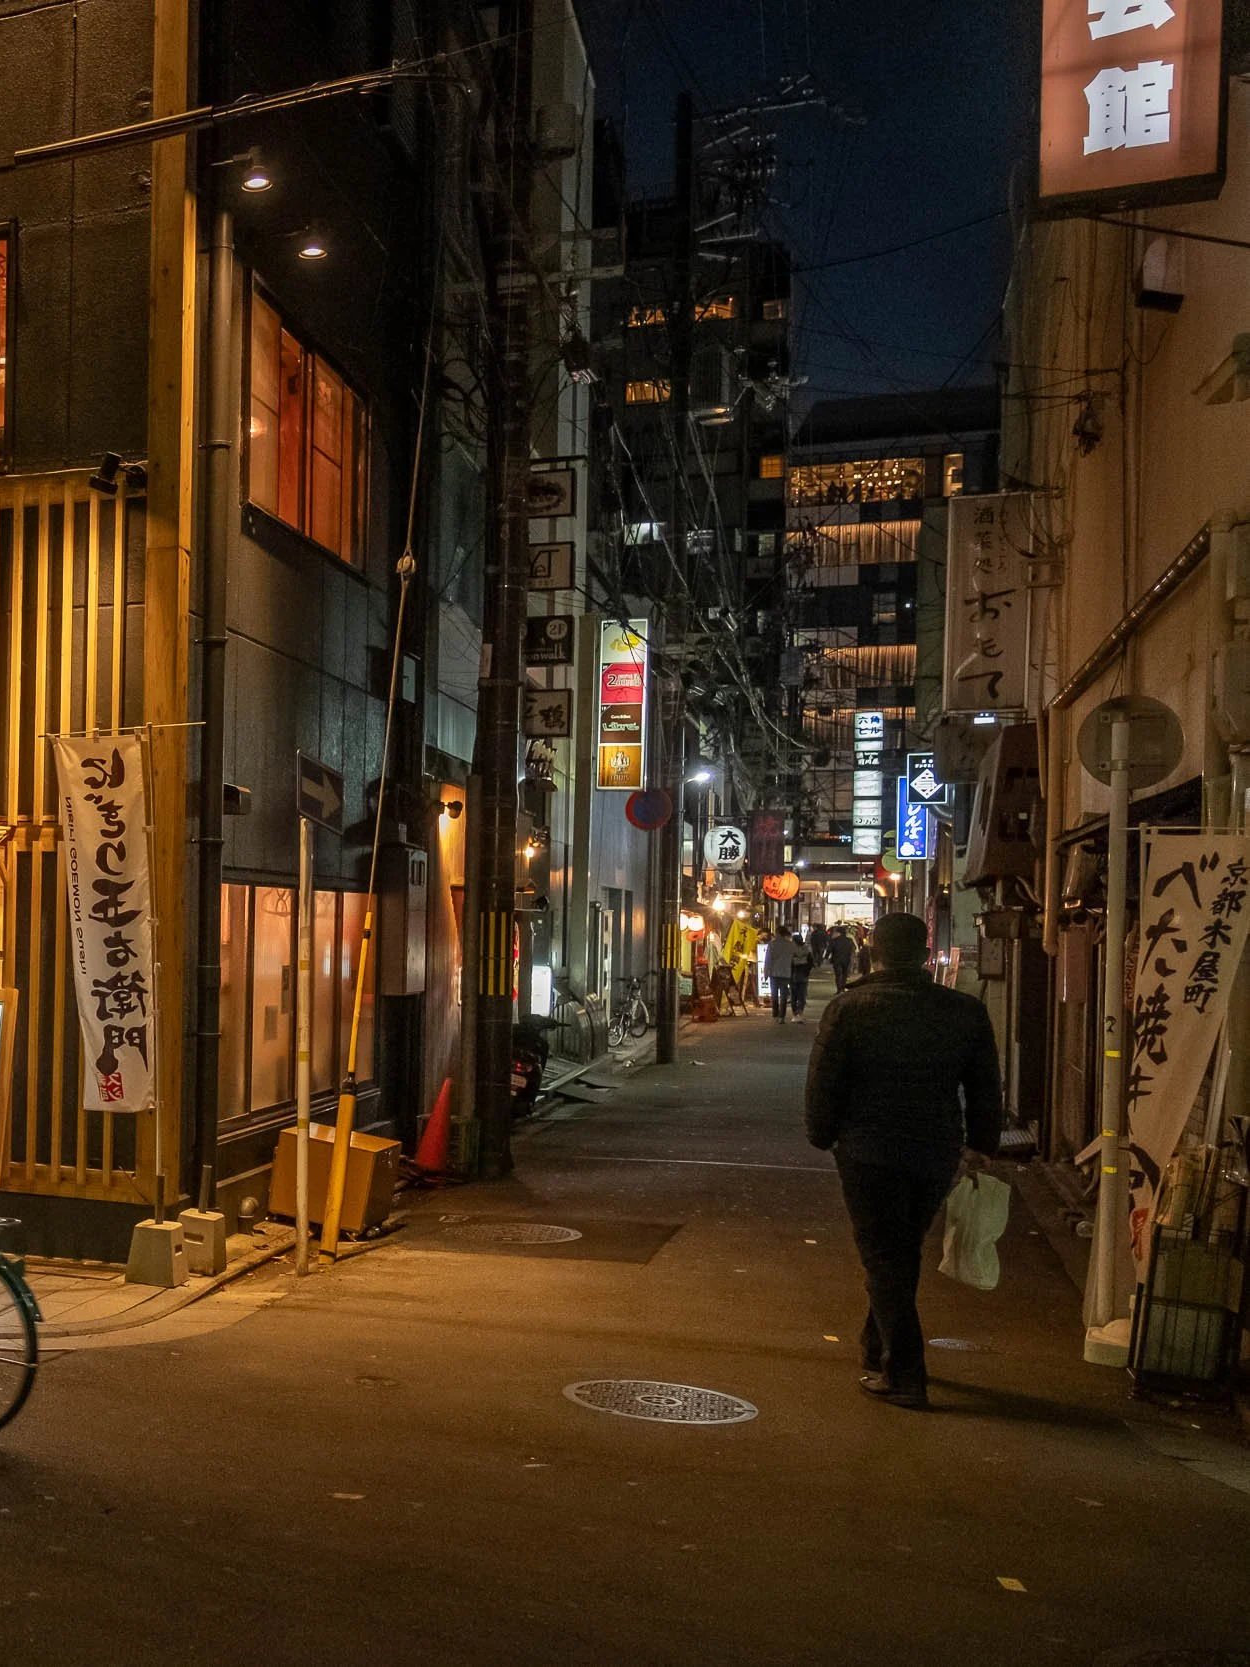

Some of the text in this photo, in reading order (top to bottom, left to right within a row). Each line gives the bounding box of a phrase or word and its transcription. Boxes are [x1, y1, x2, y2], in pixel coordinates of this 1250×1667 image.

[858, 715, 881, 725] 六角
[858, 726, 881, 735] ビル
[718, 830, 741, 860] 大勝
[1182, 856, 1249, 1014] 京都木屋町
